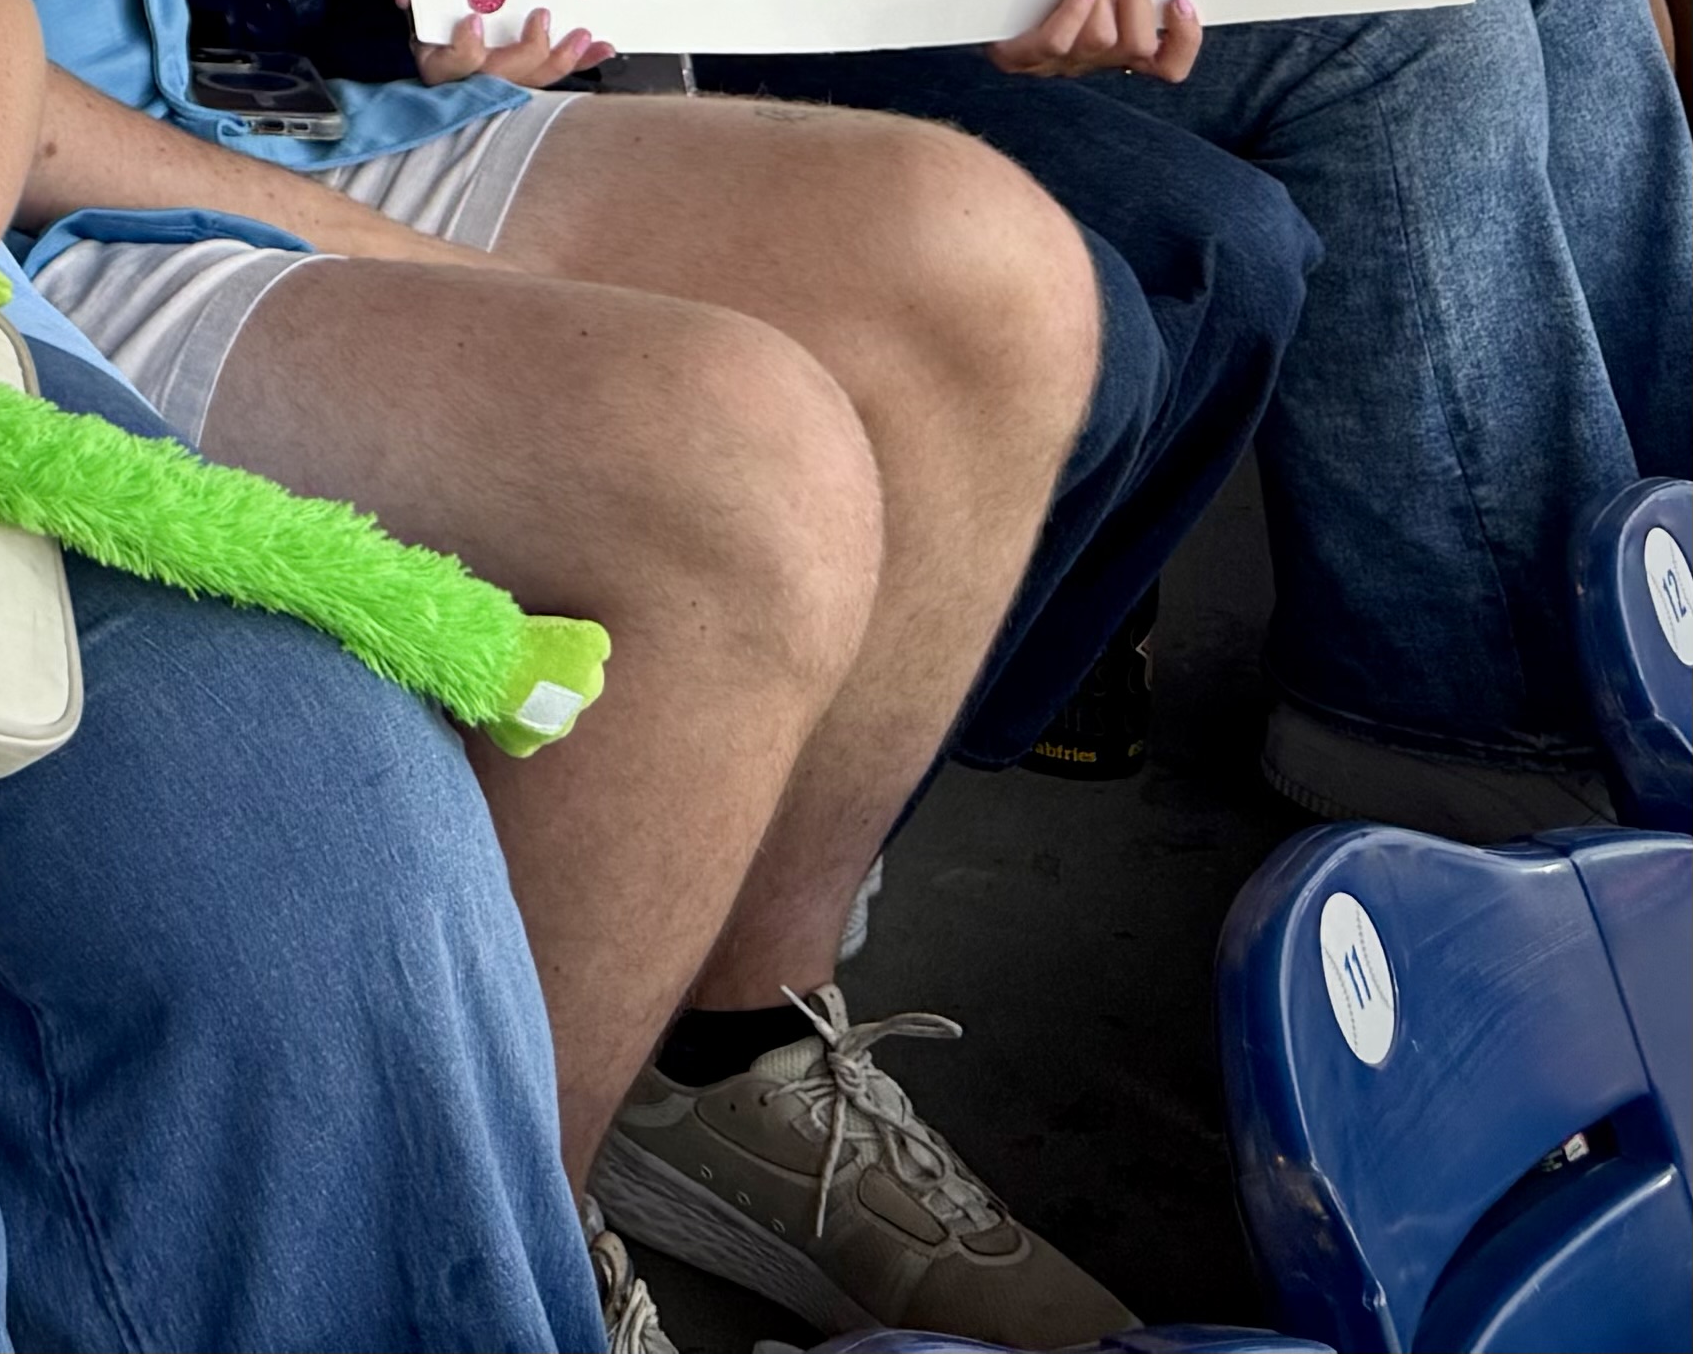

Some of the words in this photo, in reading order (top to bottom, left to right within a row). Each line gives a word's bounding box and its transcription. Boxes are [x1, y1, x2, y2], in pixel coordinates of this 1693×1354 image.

[1662, 568, 1688, 624] 12
[1032, 741, 1098, 763] abfries
[1344, 944, 1372, 1010] 11
